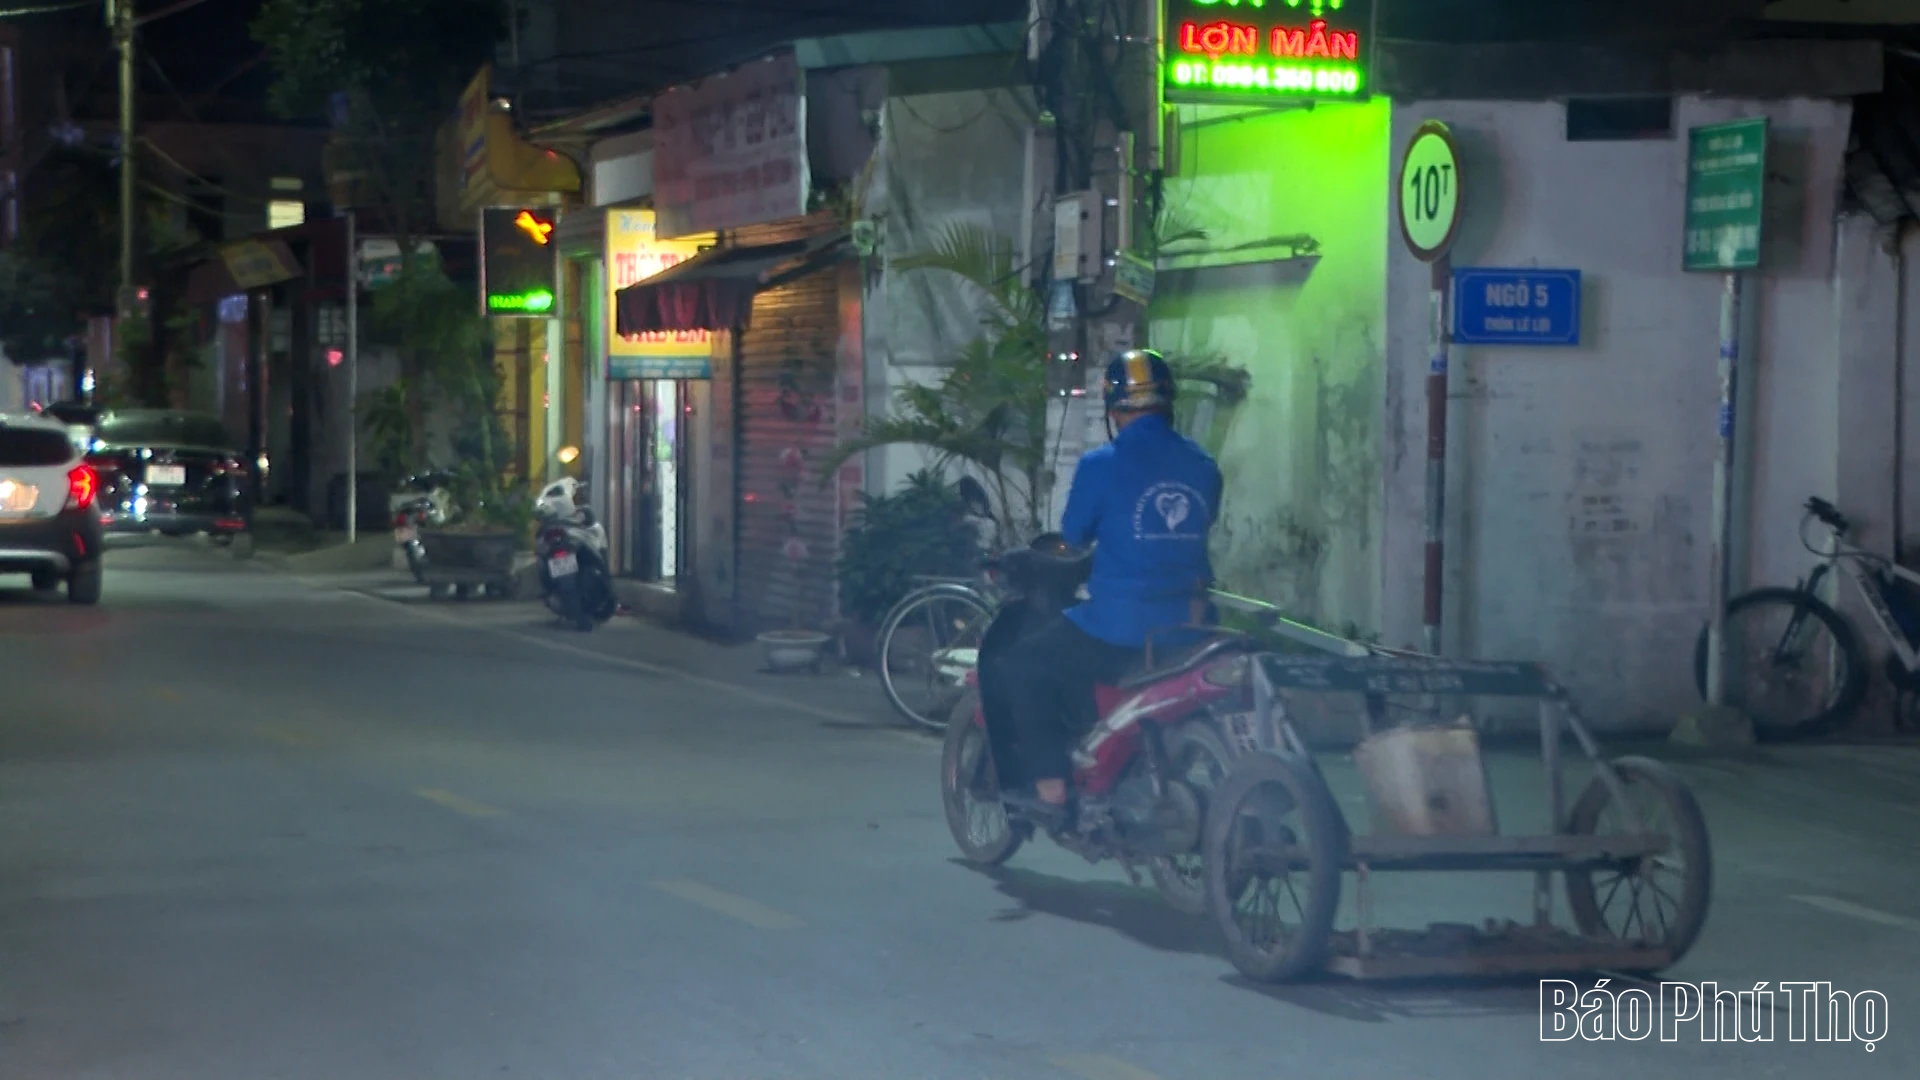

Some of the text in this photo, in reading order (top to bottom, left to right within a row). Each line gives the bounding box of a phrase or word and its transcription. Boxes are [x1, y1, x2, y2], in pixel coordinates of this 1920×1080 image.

[1182, 23, 1257, 59] LỢN
[1486, 279, 1549, 307] NGÕ 5
